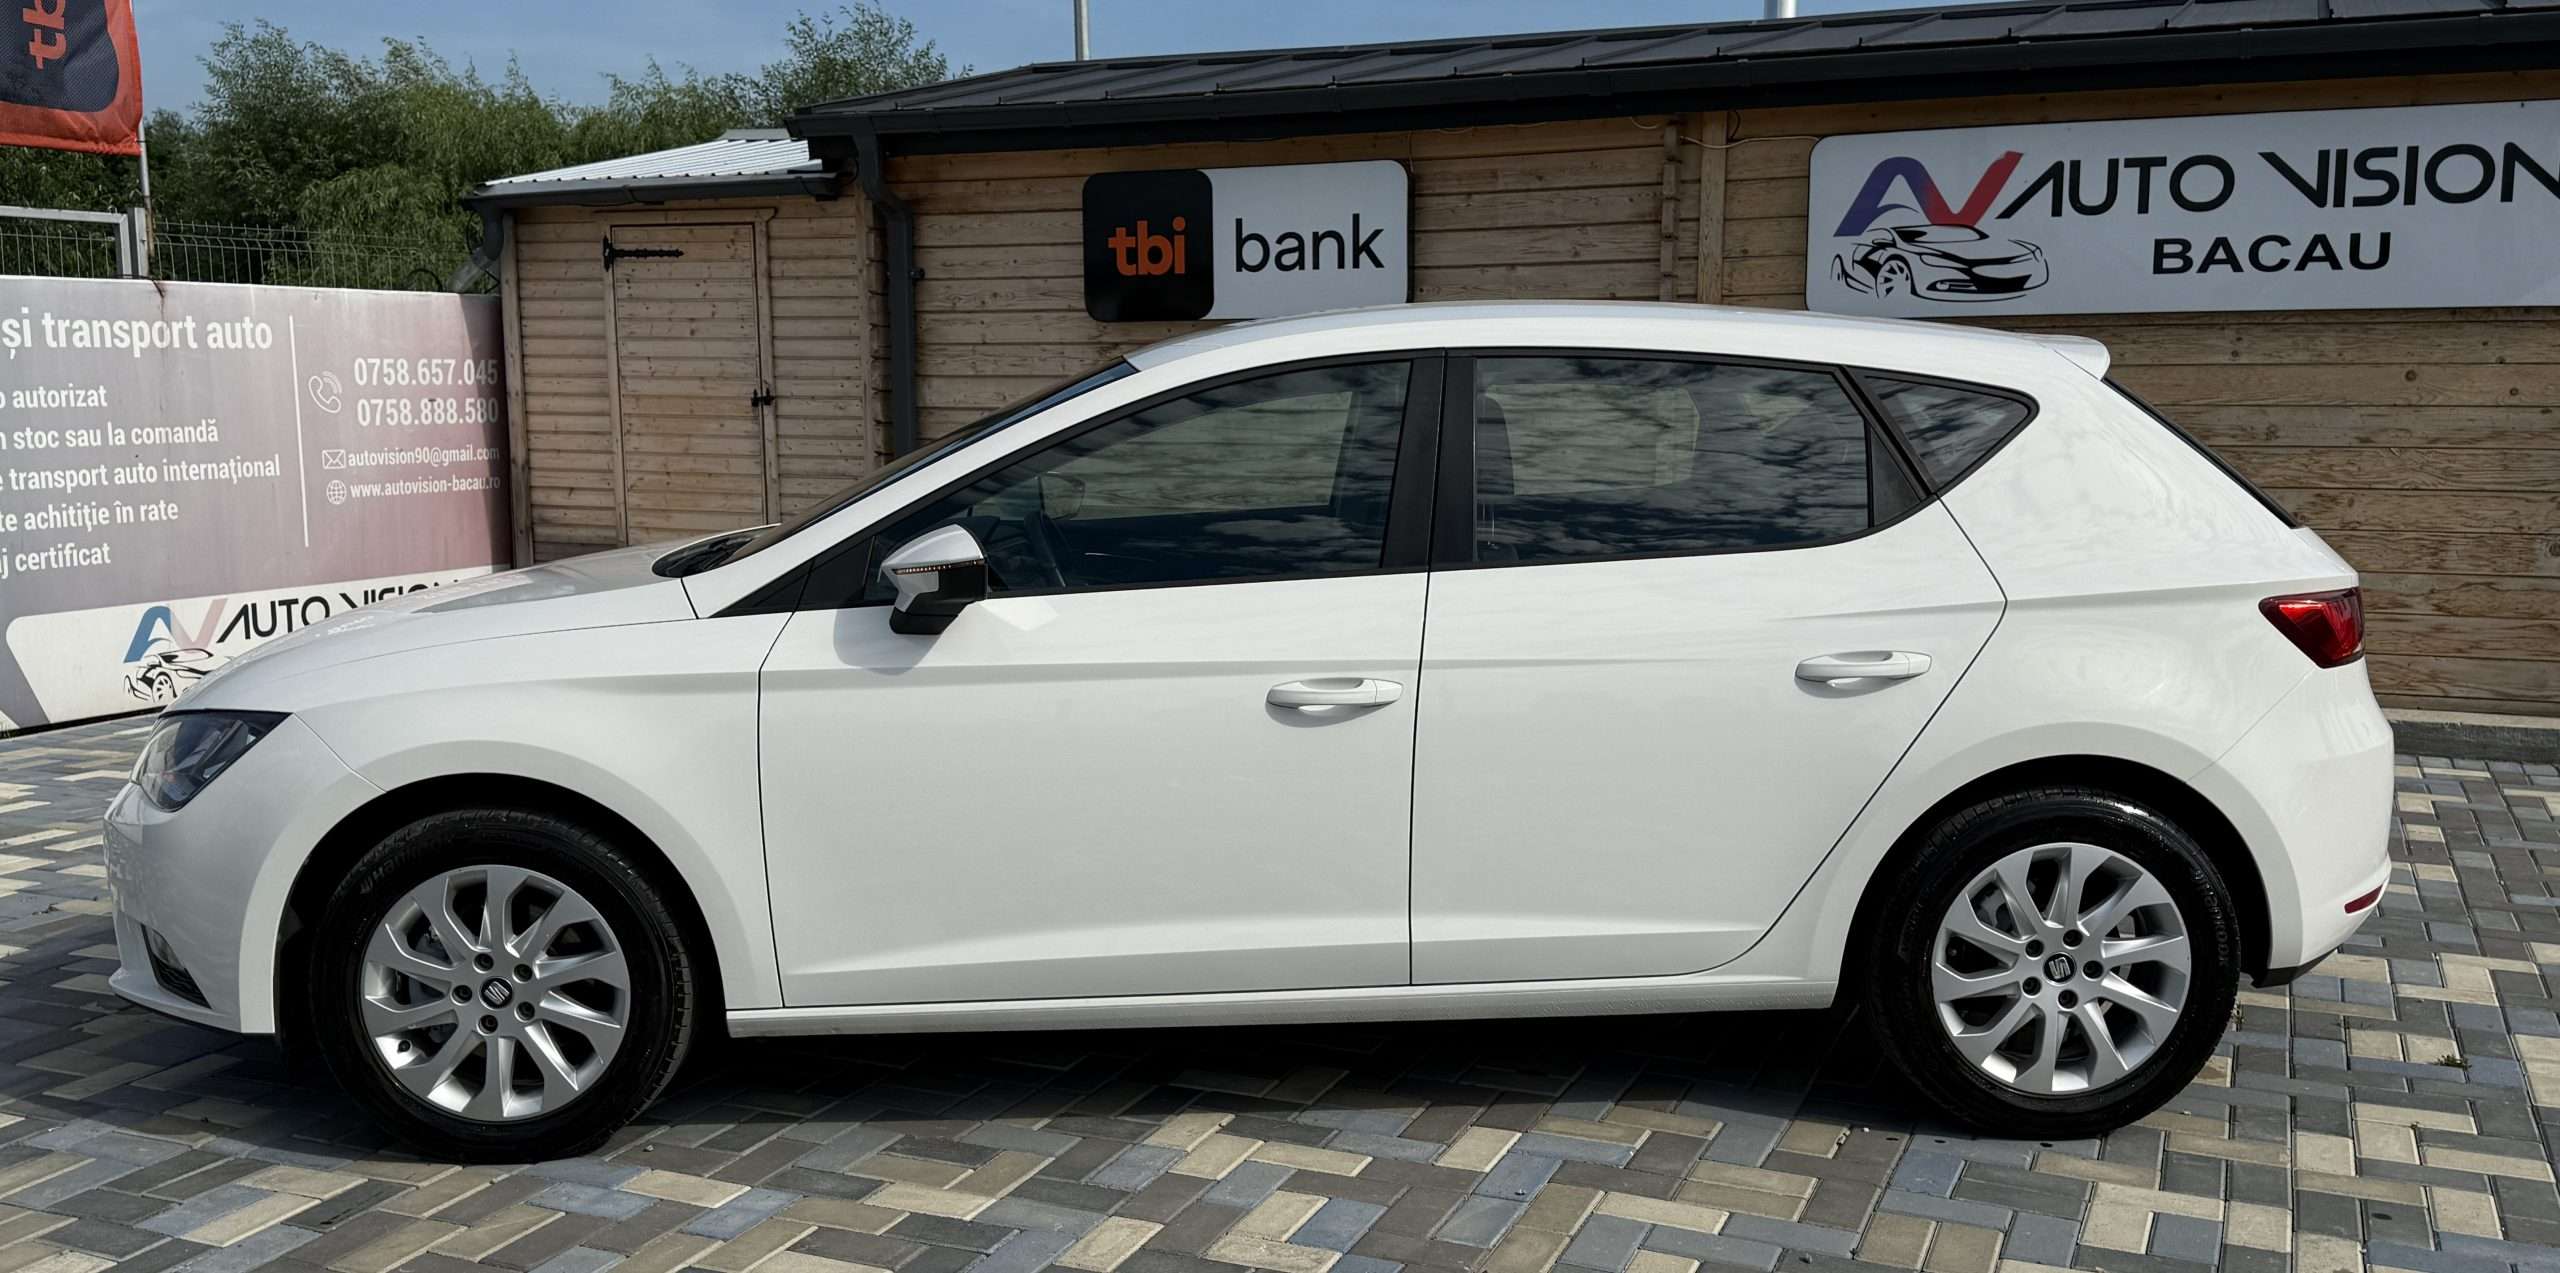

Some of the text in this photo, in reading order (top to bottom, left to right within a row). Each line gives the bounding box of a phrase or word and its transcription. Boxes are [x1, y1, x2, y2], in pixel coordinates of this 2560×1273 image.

[1995, 141, 2560, 220] AUTO VISION
[1107, 212, 1385, 277] tbi bank
[2151, 231, 2392, 275] BACAU
[42, 312, 198, 358] transport
[206, 316, 273, 349] auto
[354, 357, 499, 386] 0758.657.045
[12, 383, 108, 409] autorizat
[357, 398, 500, 426] 0758.888.580
[13, 427, 60, 450] stoc
[65, 428, 101, 448] sau
[107, 421, 126, 446] la
[131, 418, 219, 446] comandă
[8, 464, 109, 494] transport
[114, 462, 158, 485] auto
[350, 474, 500, 498] www.autovision-bacau.ro
[113, 500, 134, 524] în
[140, 499, 179, 523] rate
[15, 543, 111, 572] certificat
[216, 595, 331, 644] AUTO
